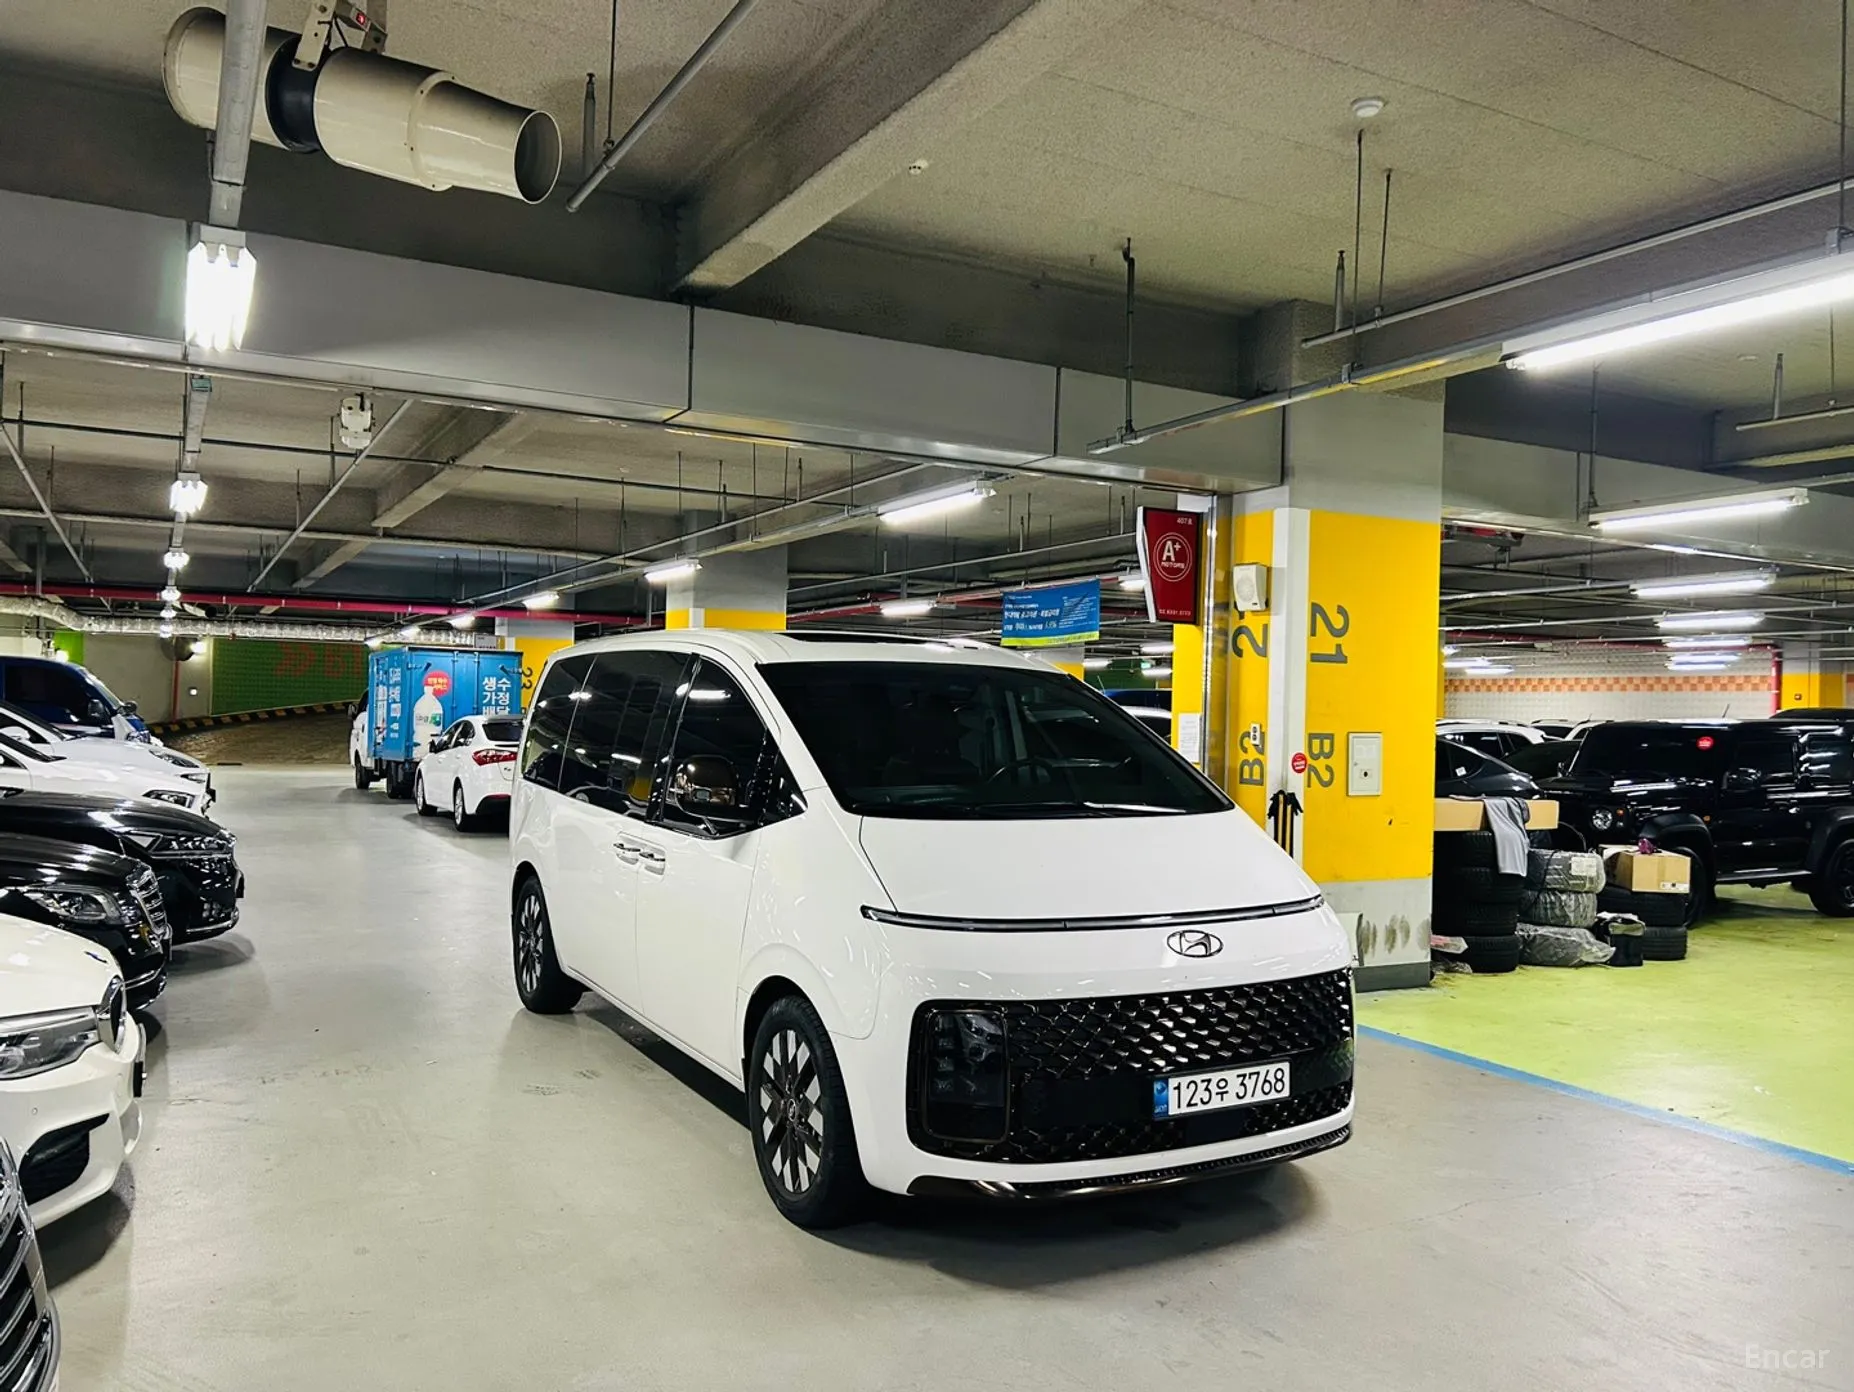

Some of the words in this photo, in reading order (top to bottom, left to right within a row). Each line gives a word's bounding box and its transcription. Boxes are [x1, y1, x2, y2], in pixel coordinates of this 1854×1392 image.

[1162, 540, 1182, 562] A+
[1232, 607, 1269, 658] 2
[1310, 602, 1350, 664] 21
[482, 676, 512, 692] 생수
[482, 692, 511, 706] 가정
[1238, 730, 1266, 787] B2
[1306, 732, 1335, 788] B2
[1173, 1077, 1229, 1109] 123우
[1235, 1067, 1286, 1100] 3768
